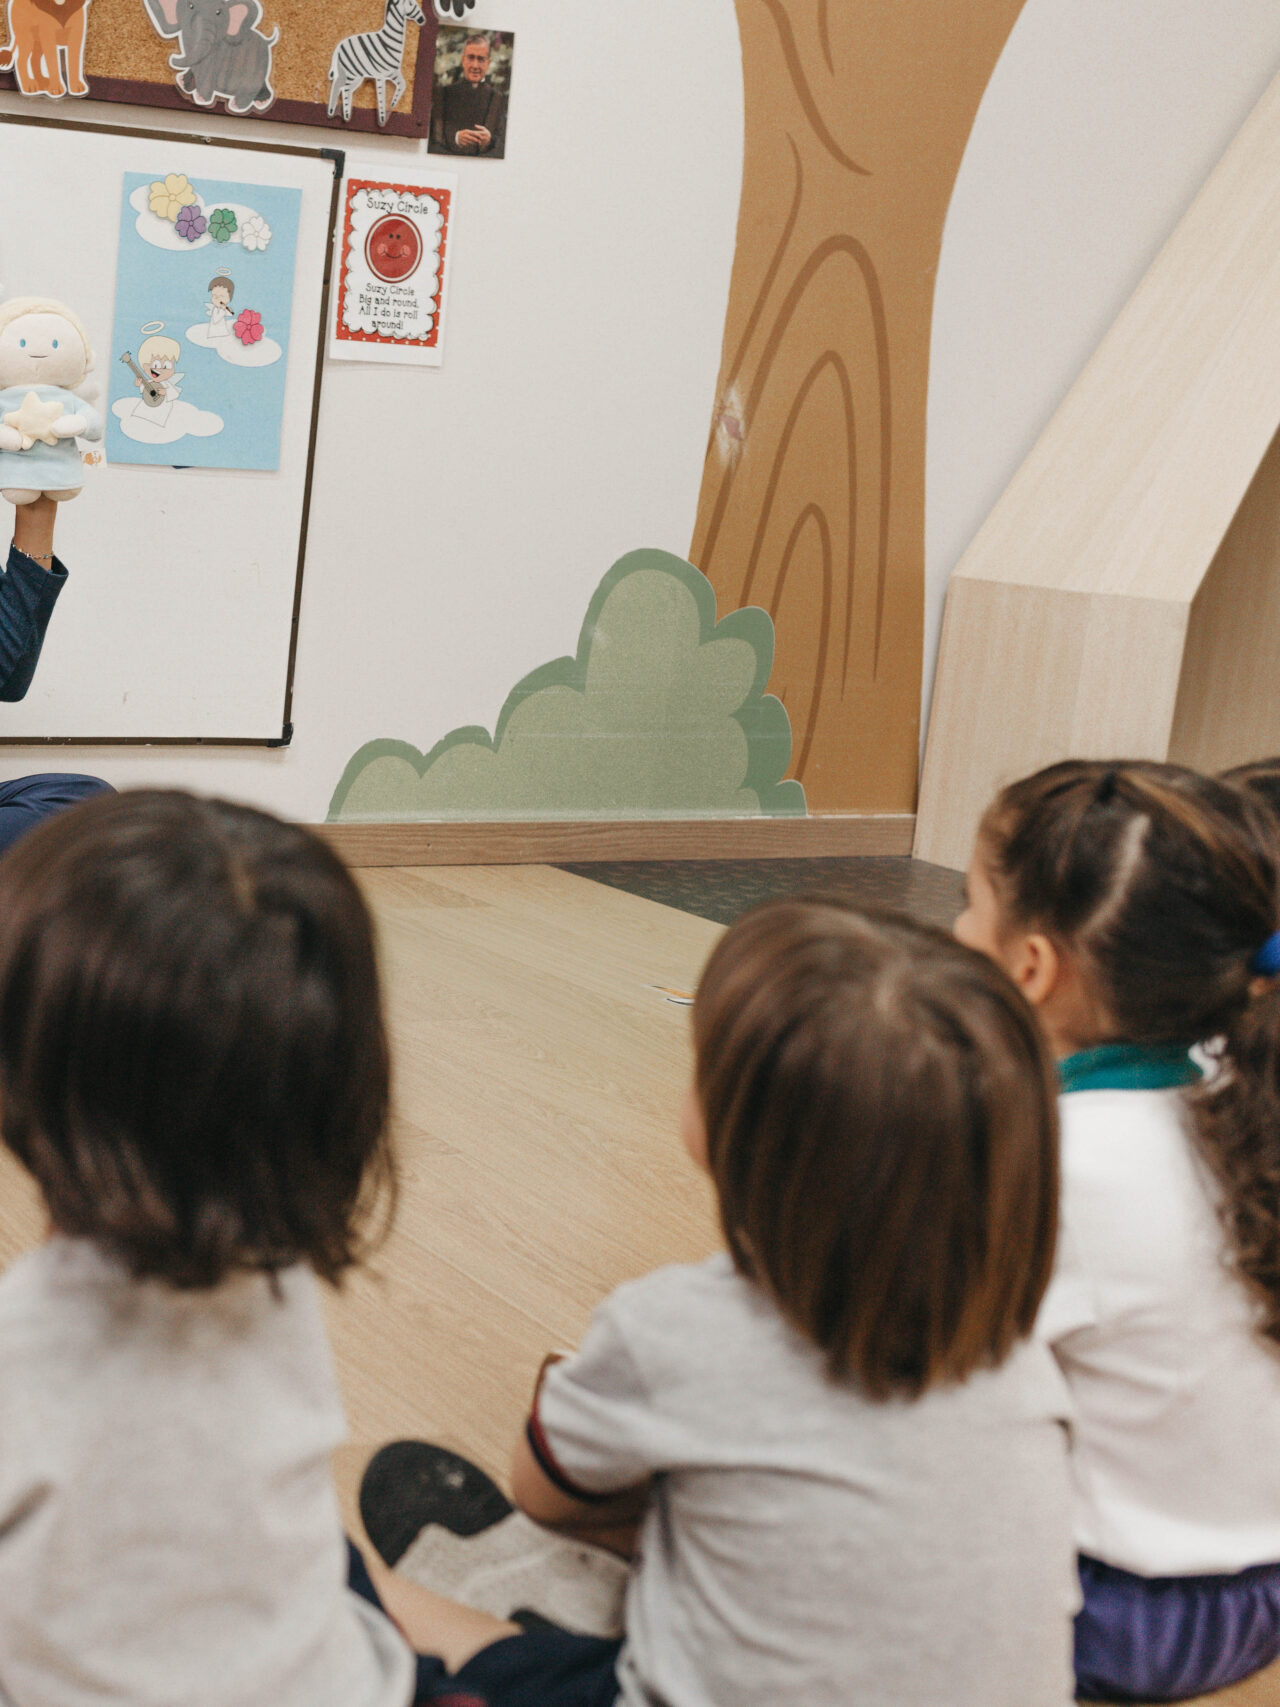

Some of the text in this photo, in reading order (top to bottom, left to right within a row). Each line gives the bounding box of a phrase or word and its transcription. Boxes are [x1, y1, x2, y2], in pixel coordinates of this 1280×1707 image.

[367, 197, 429, 215] Suzy Circle
[366, 283, 415, 296] Suzy Circle
[359, 294, 372, 306] Big
[375, 296, 390, 306] and
[359, 305, 418, 320] All I do is roll
